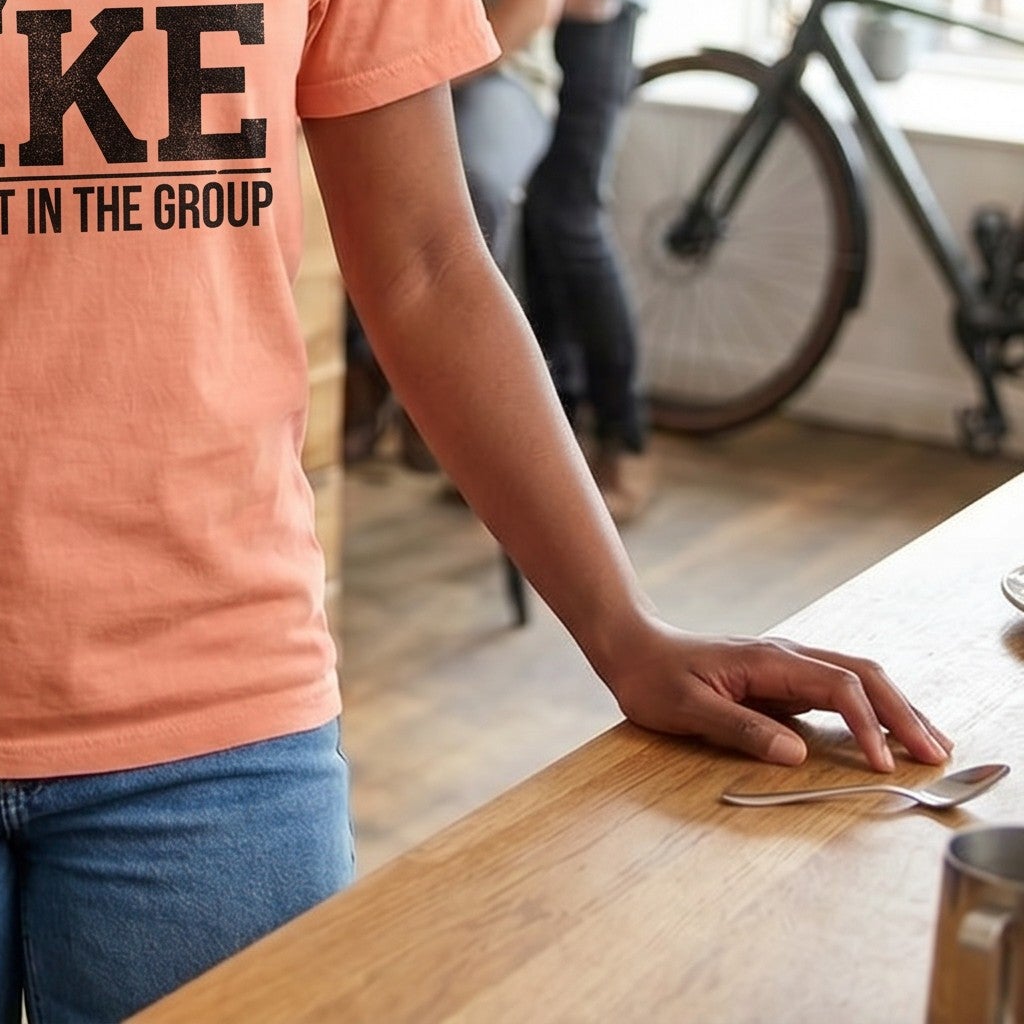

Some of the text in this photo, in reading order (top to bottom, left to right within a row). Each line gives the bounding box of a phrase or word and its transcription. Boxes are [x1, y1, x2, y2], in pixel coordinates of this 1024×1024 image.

[27, 187, 62, 235] IN
[73, 185, 142, 233] THE
[154, 181, 273, 230] GROUP
